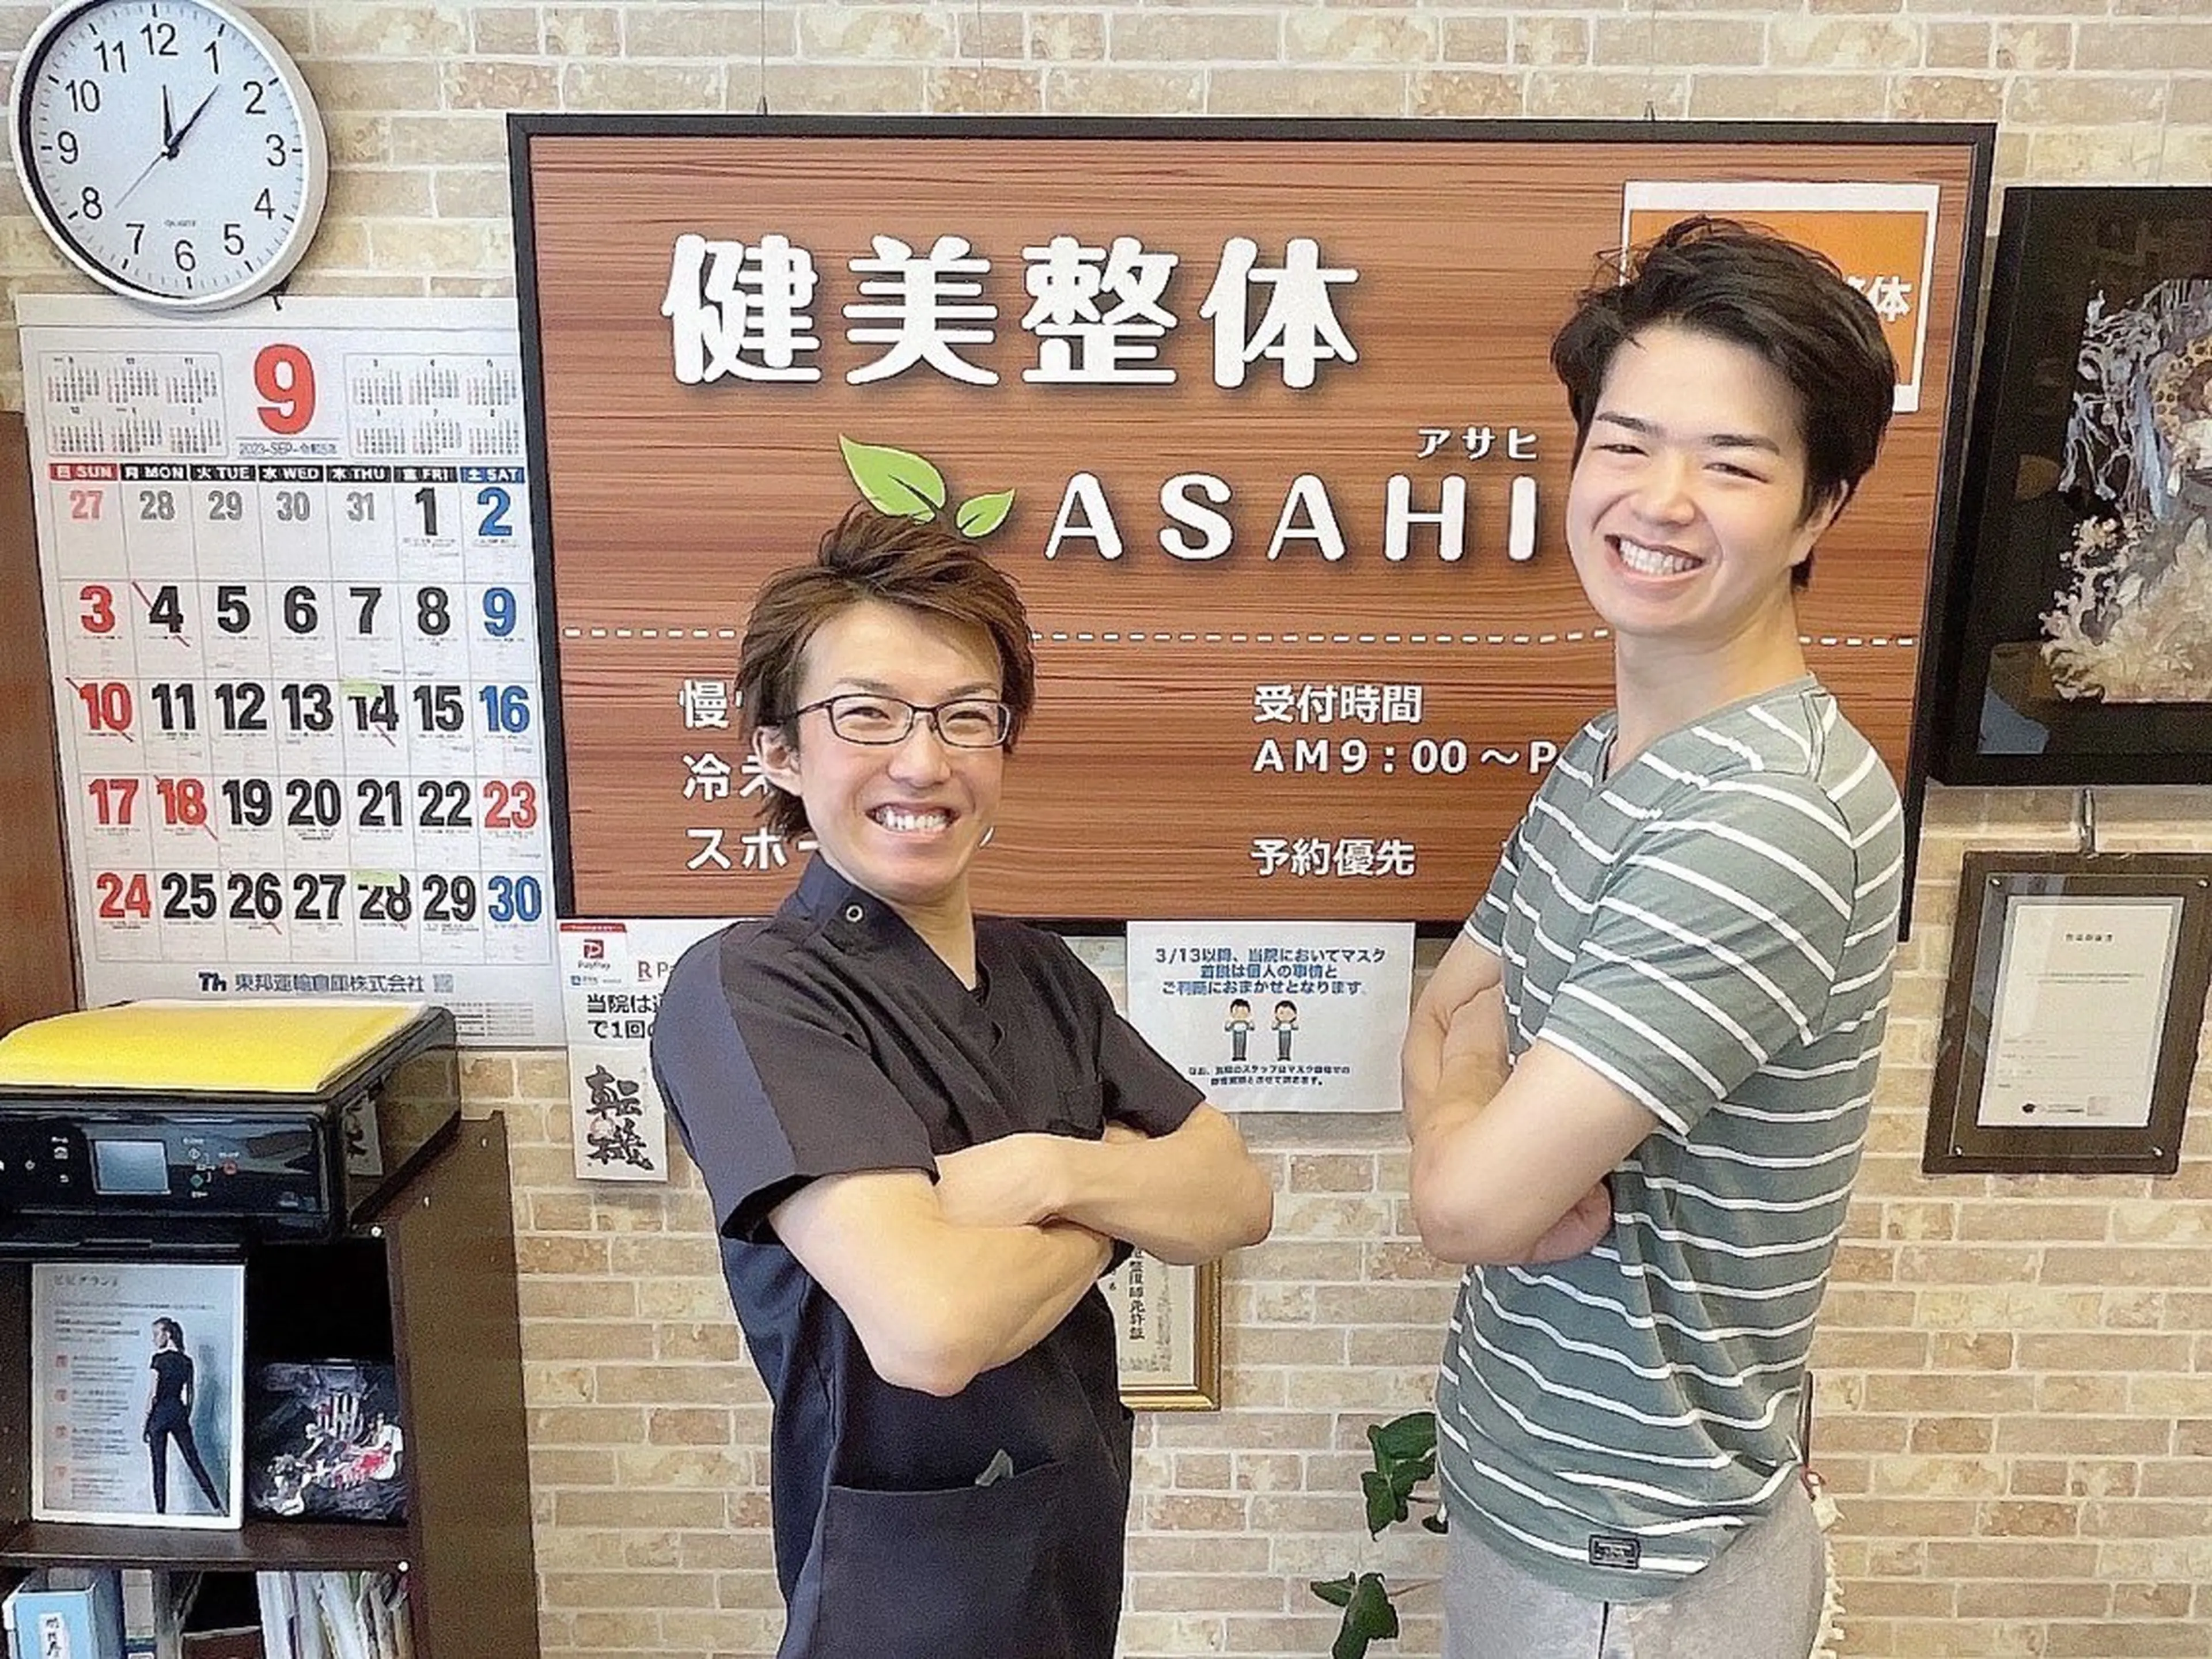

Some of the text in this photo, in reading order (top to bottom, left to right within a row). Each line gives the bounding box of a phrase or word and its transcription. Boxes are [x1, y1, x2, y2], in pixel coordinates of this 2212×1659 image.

[94, 40, 127, 73] 11
[142, 23, 179, 56] 12
[204, 40, 219, 74] 1
[66, 79, 100, 112] 10
[243, 81, 267, 115] 2
[58, 131, 79, 164] 9
[266, 134, 286, 166] 3
[81, 187, 103, 220] 8
[254, 188, 276, 219] 4
[126, 224, 145, 255] 7
[175, 240, 196, 271] 6
[224, 224, 244, 256] 5
[662, 233, 1359, 389] 健美整体
[254, 343, 316, 435] 9
[1416, 426, 1538, 460] アサヒ
[58, 466, 70, 479] 日
[78, 465, 112, 478] SUN
[126, 466, 138, 479] 月
[145, 466, 184, 479] MON
[197, 466, 211, 479] 火
[219, 466, 249, 479] TUE
[283, 467, 319, 479] WED
[351, 468, 384, 480] THU
[422, 469, 449, 481] FRI
[468, 469, 482, 481] 土
[487, 469, 518, 481] SAT
[70, 487, 512, 536] 27 28 29 30 31 1 2
[1044, 472, 1537, 561] ASAHI
[80, 585, 517, 637] 3 4 5 6 7 8 9
[79, 683, 530, 733] 10 11 12 13 14 15 16
[679, 679, 744, 729] 慢
[1252, 684, 1424, 724] 受付時間
[88, 779, 537, 829] 17 18 19 20 21 22 23
[1250, 838, 1416, 876] 予約優先
[97, 872, 541, 922] 24 25 26 27 28 29 30
